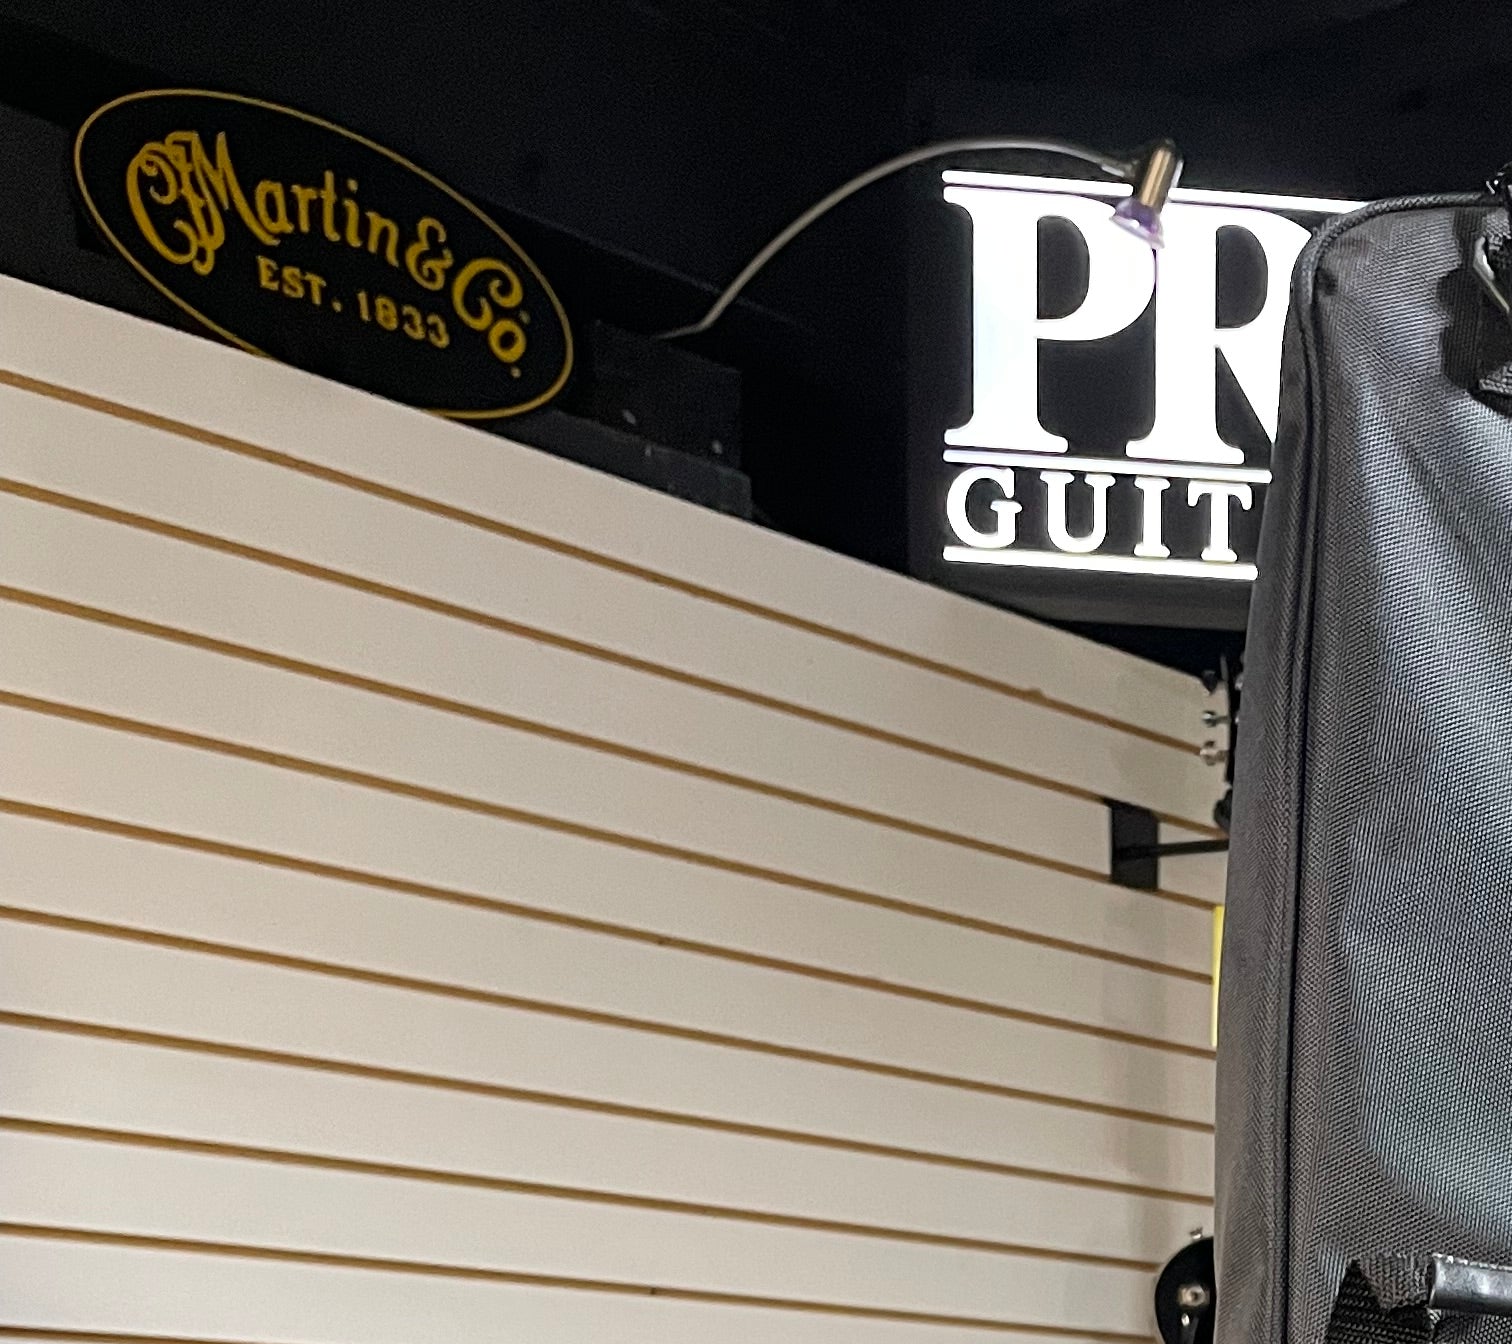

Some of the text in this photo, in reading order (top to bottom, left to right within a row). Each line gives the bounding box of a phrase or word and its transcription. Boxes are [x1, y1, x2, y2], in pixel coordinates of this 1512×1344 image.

[257, 256, 449, 348] EST. 1833
[943, 186, 1312, 464] PR
[946, 466, 1253, 562] GUIT
